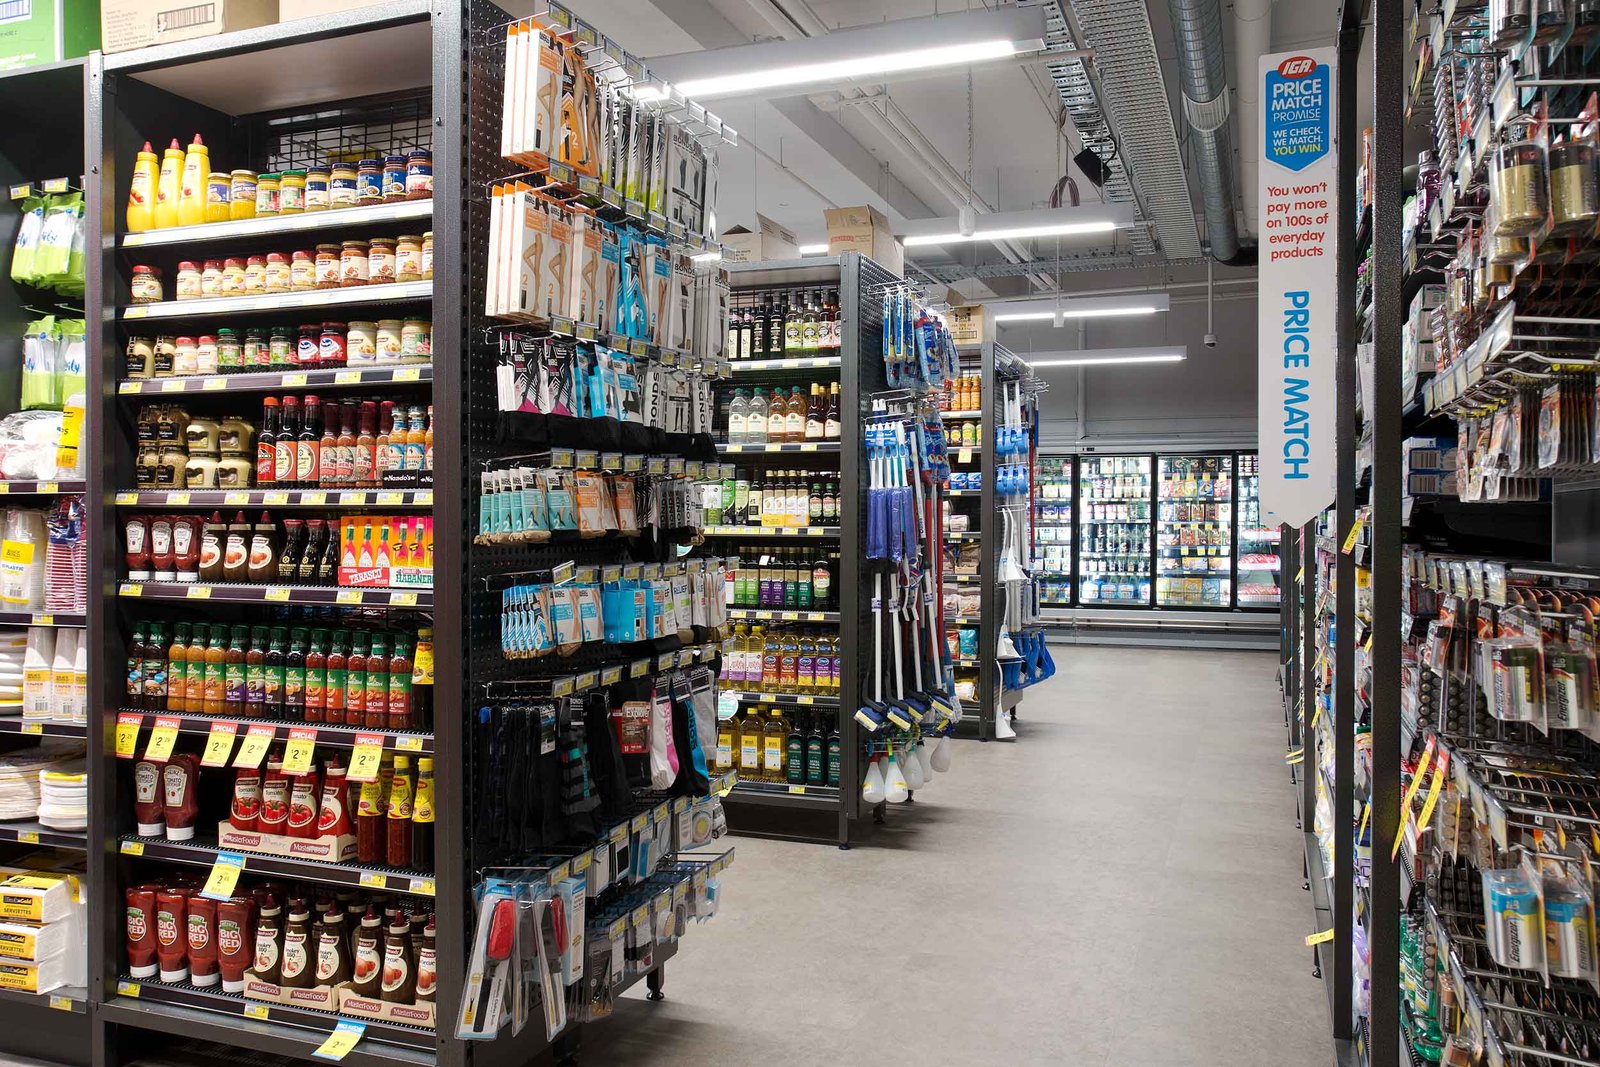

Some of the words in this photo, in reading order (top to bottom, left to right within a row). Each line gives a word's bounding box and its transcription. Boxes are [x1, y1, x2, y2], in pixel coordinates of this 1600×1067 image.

[1282, 60, 1312, 76] IGA
[1273, 78, 1322, 99] PRICE
[1271, 95, 1322, 111] MATCH
[1273, 107, 1321, 122] PROMISE
[1273, 129, 1288, 138] WE
[1289, 126, 1324, 137] CHECK.
[1273, 138, 1288, 147] WE
[1289, 135, 1324, 145] MATCH.
[1273, 145, 1297, 156] YOU
[1298, 143, 1324, 154] WIN.
[1267, 185, 1290, 198] You
[1292, 181, 1328, 196] won't
[1267, 202, 1291, 216] pay
[1294, 199, 1328, 211] more
[1266, 218, 1282, 229] on
[1285, 215, 1312, 227] 100s
[1315, 212, 1329, 224] of
[1269, 230, 1325, 245] everyday
[1271, 246, 1324, 262] products
[1284, 291, 1309, 368] PRICE
[1284, 377, 1309, 480] MATCH
[1558, 681, 1570, 723] Energizer
[119, 716, 141, 725] SPECIAL
[157, 719, 180, 729] SPECIAL
[212, 723, 236, 733] SPECIAL
[250, 727, 274, 738] SPECIAL
[290, 729, 316, 741] SPECIAL
[357, 734, 383, 745] SPECIAL
[128, 917, 143, 926] BIG
[158, 921, 174, 930] BIG
[128, 926, 145, 935] RED
[158, 930, 175, 939] RED
[189, 925, 205, 934] BIG
[220, 930, 238, 938] BIG
[189, 933, 207, 942] RED
[220, 938, 240, 947] RED
[1509, 920, 1521, 963] Energizer
[293, 990, 329, 1001] MasterFoods
[346, 1000, 381, 1012] MasterFoods
[393, 1008, 429, 1021] MasterFoods
